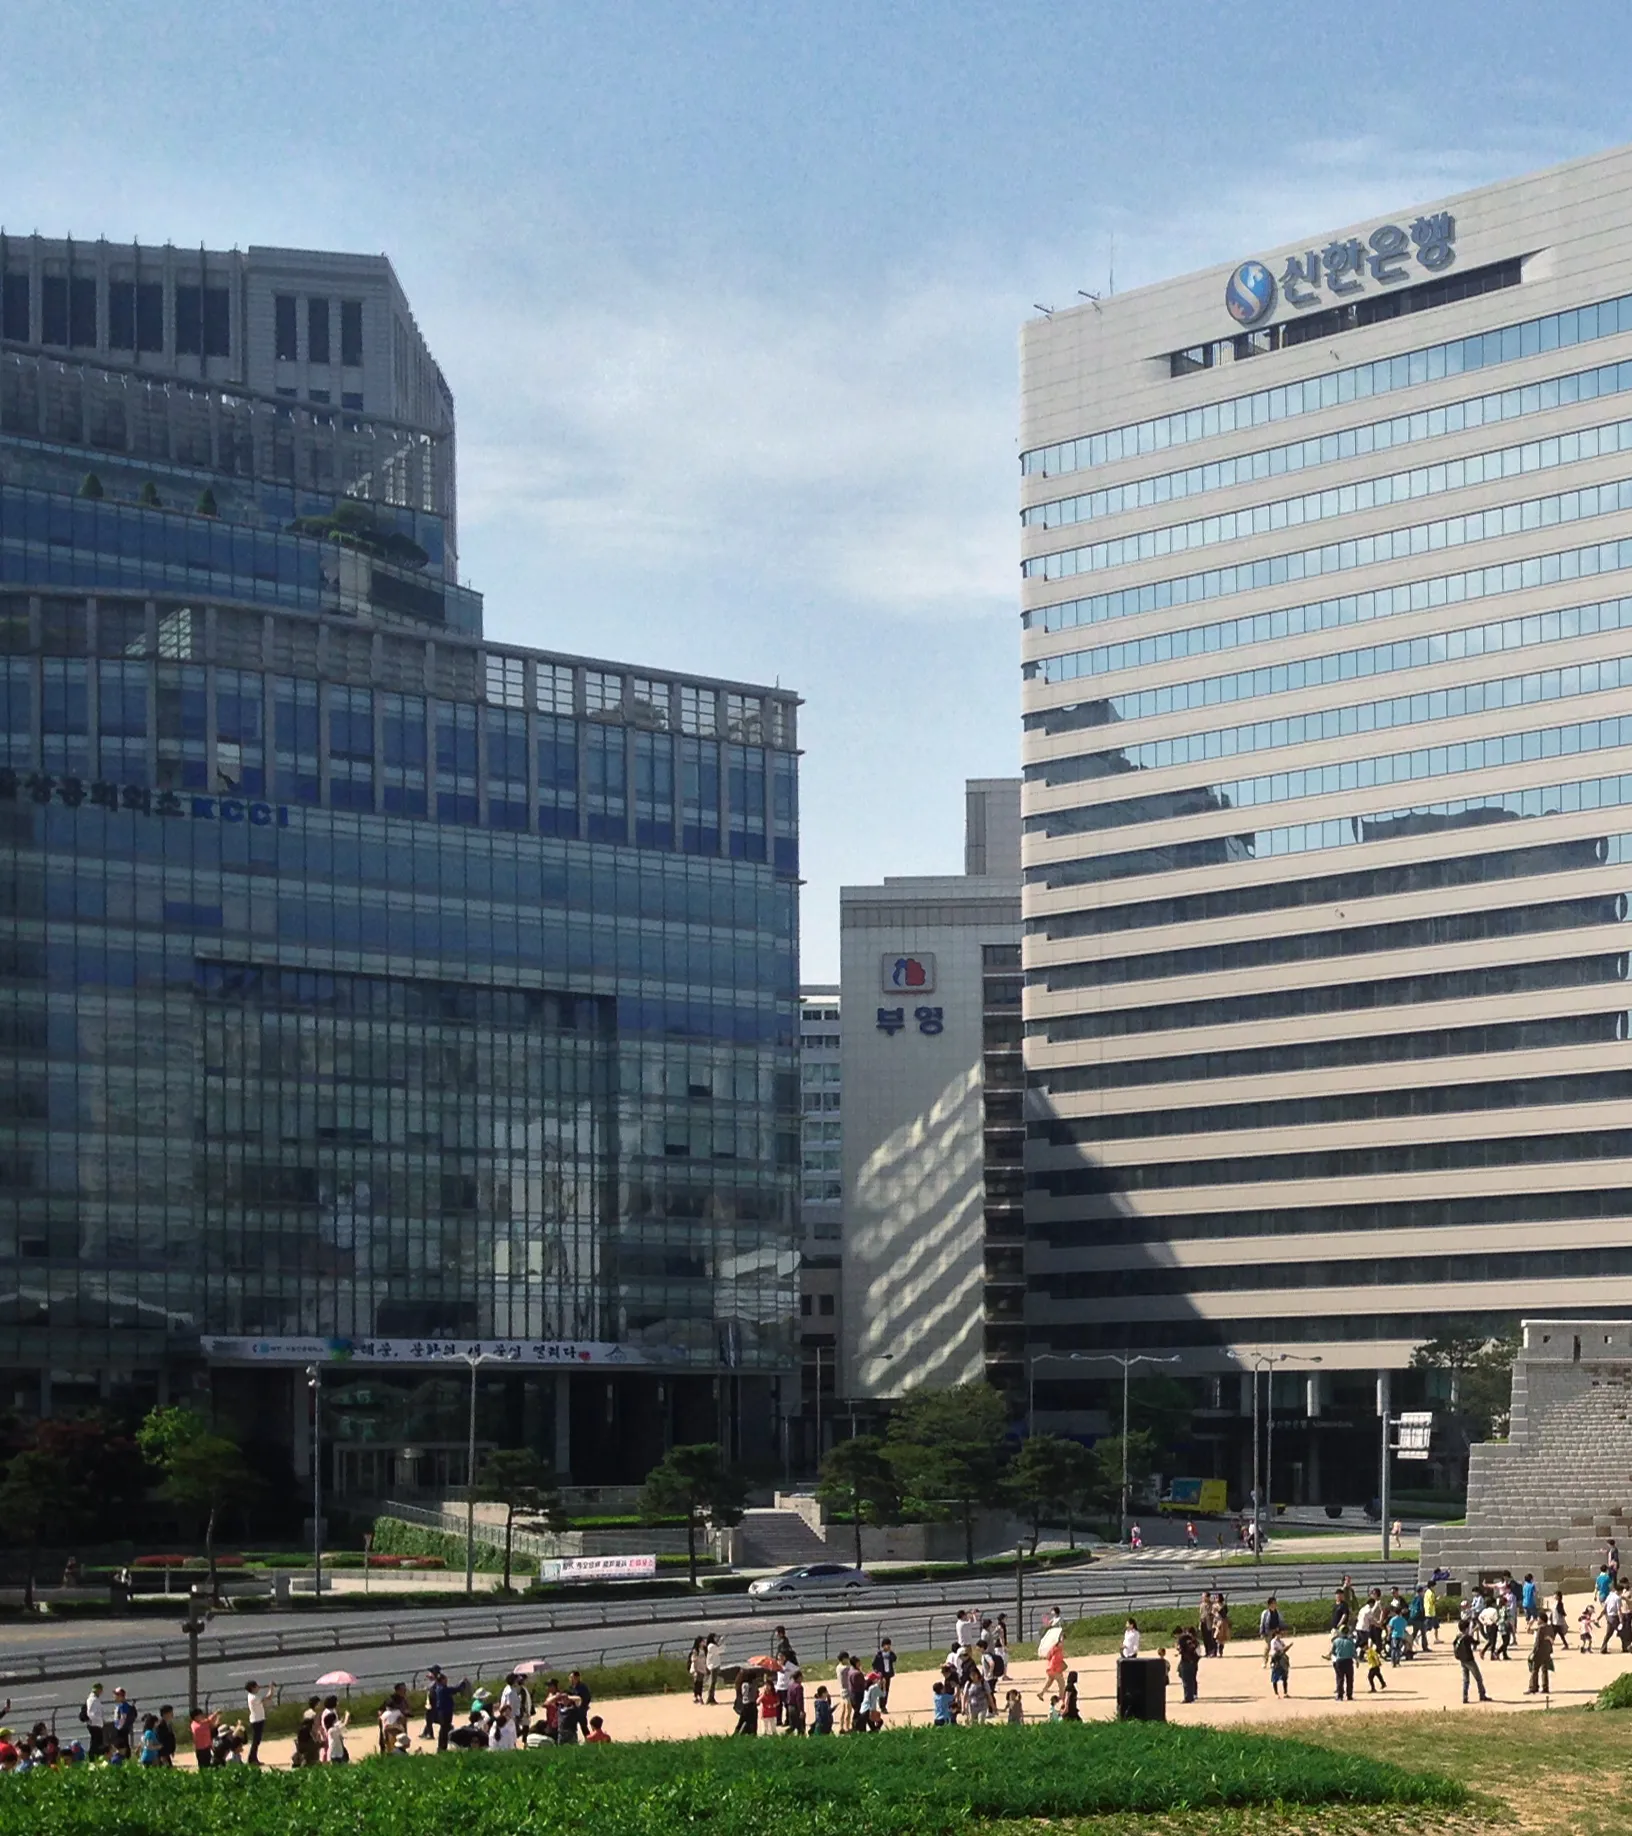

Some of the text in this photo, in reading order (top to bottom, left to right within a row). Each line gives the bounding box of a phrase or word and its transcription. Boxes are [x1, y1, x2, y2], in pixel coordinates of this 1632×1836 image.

[1279, 212, 1456, 310] 신한은행
[191, 797, 289, 829] KCCI
[876, 1006, 944, 1036] 부영
